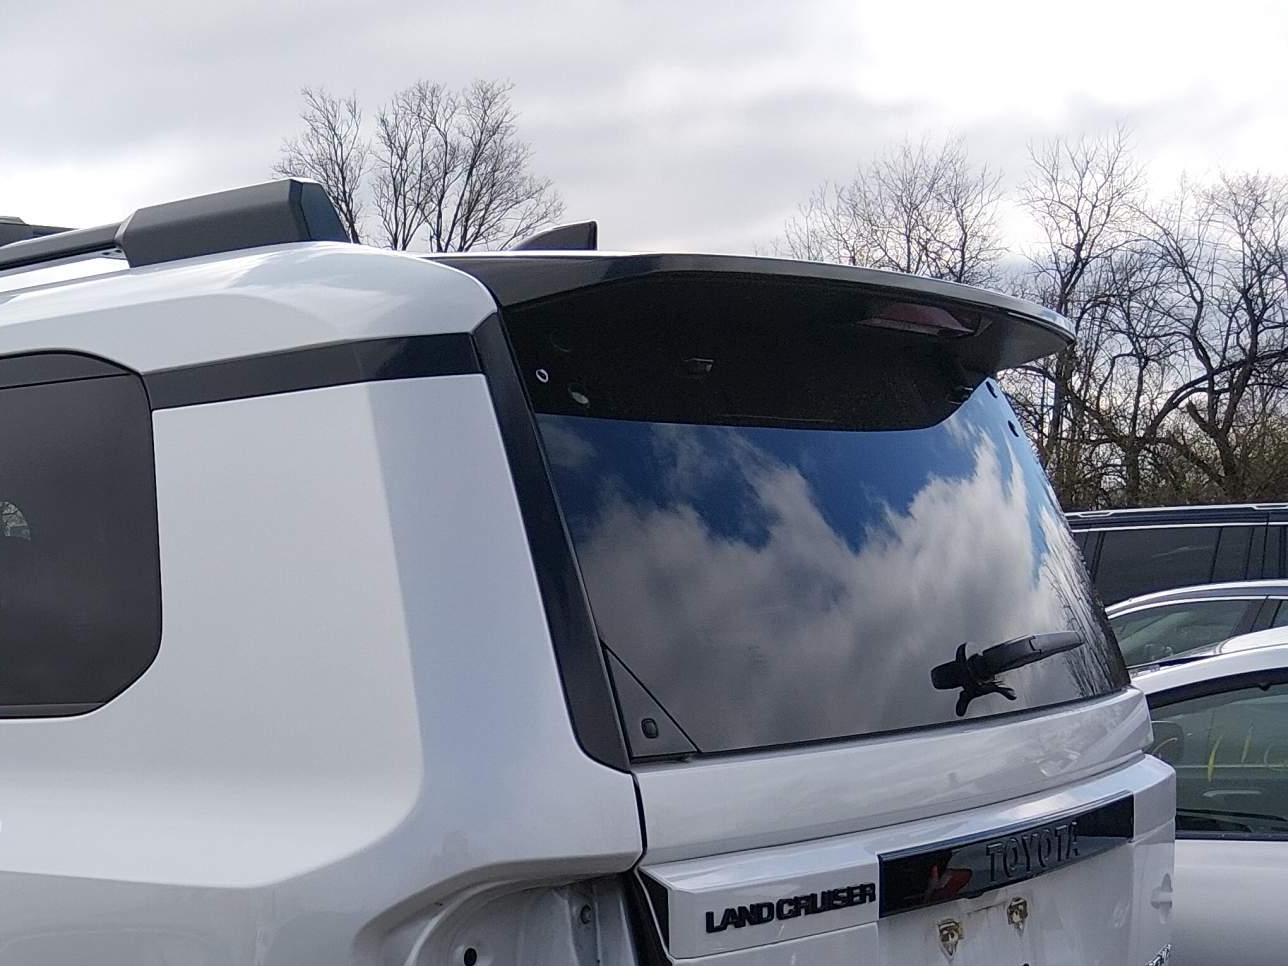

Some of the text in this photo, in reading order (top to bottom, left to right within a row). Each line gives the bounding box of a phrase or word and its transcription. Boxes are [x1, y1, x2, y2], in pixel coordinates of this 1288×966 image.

[985, 821, 1080, 883] TOYOTA
[705, 882, 876, 934] LAND CRUISER
